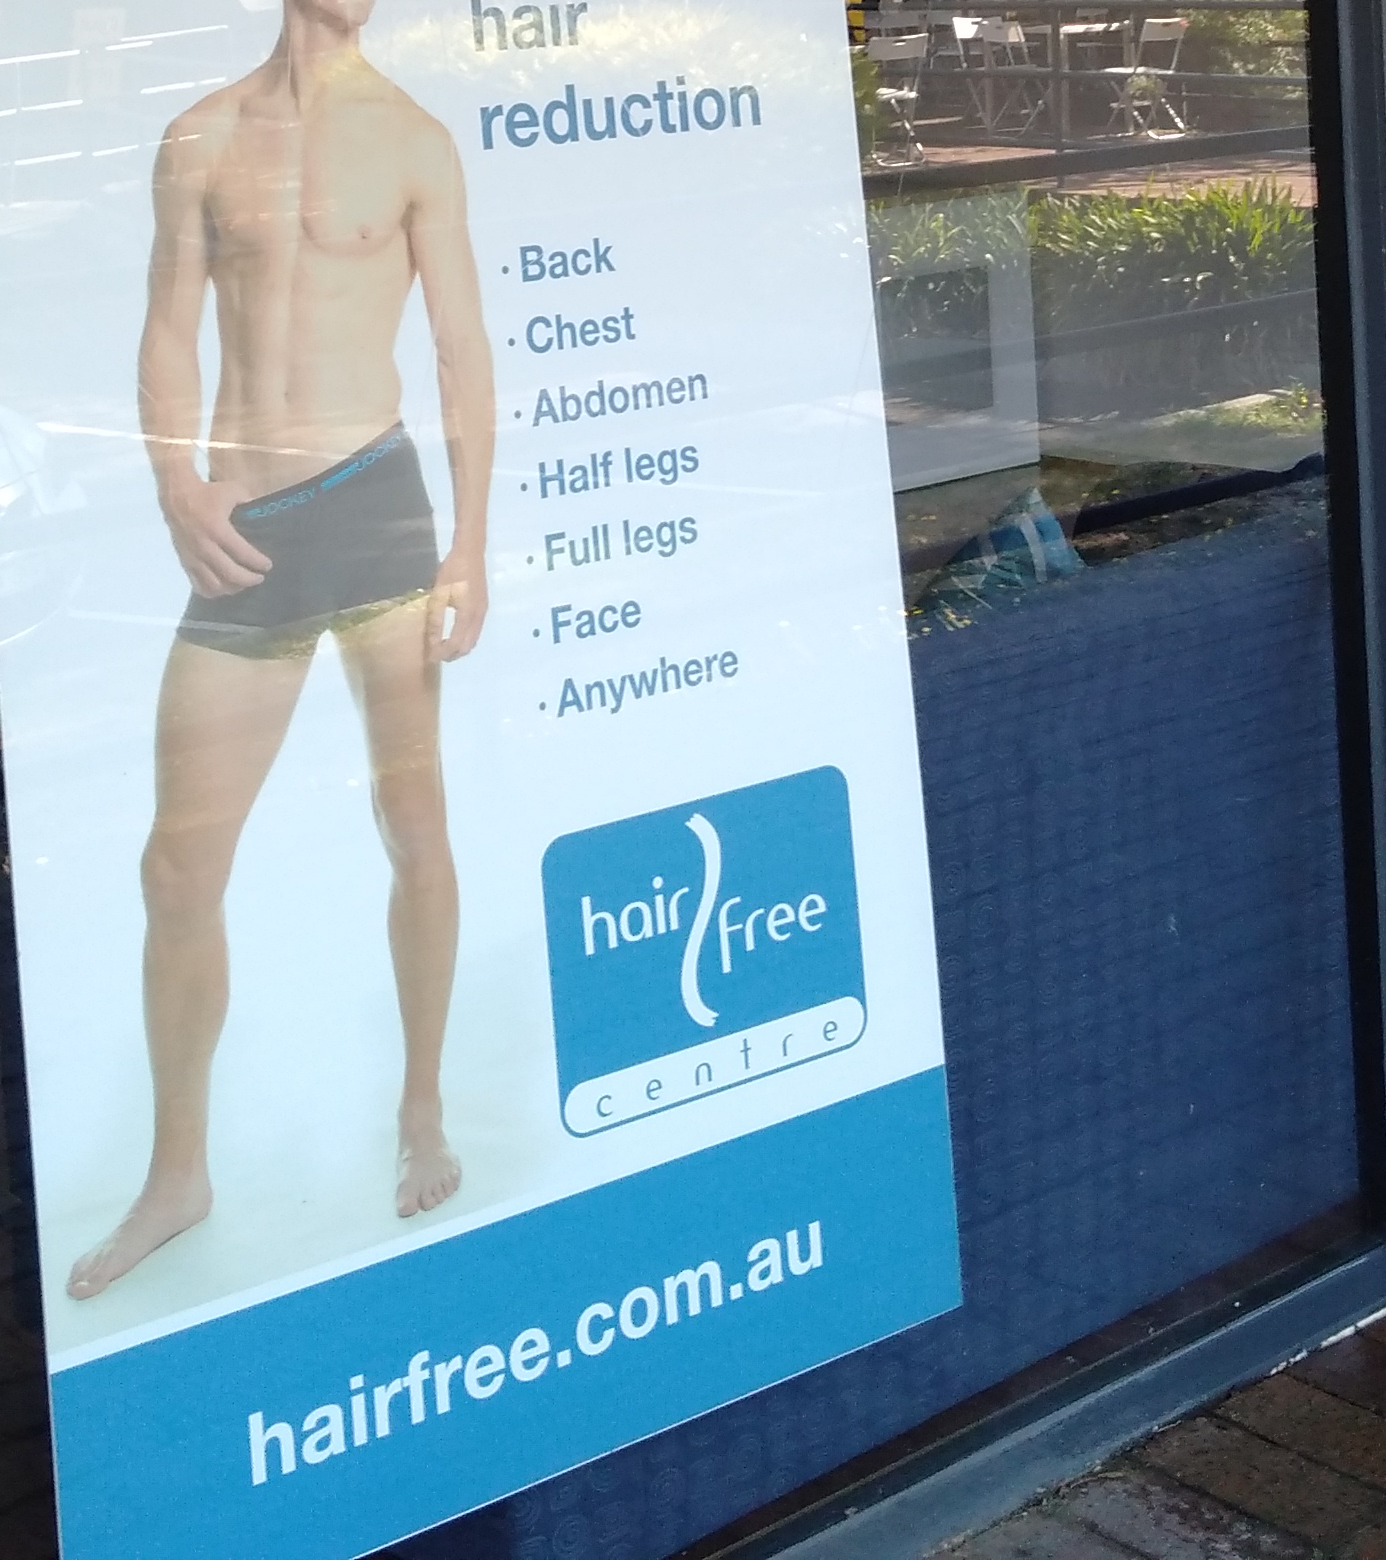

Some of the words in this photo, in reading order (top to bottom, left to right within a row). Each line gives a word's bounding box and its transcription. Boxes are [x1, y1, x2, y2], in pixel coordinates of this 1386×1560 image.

[479, 75, 762, 150] reduction
[519, 237, 616, 282] Back
[525, 306, 636, 354] Chest
[532, 373, 709, 427] Abdomen
[538, 450, 613, 499] Half
[624, 445, 699, 486] legs
[544, 523, 611, 571] Full
[622, 516, 698, 557] legs
[551, 600, 642, 644] Face
[557, 650, 739, 718] Anywhere
[581, 875, 690, 956] hair
[718, 893, 828, 974] free
[596, 1020, 839, 1118] centre
[248, 1220, 824, 1486] hairfree.com.au
